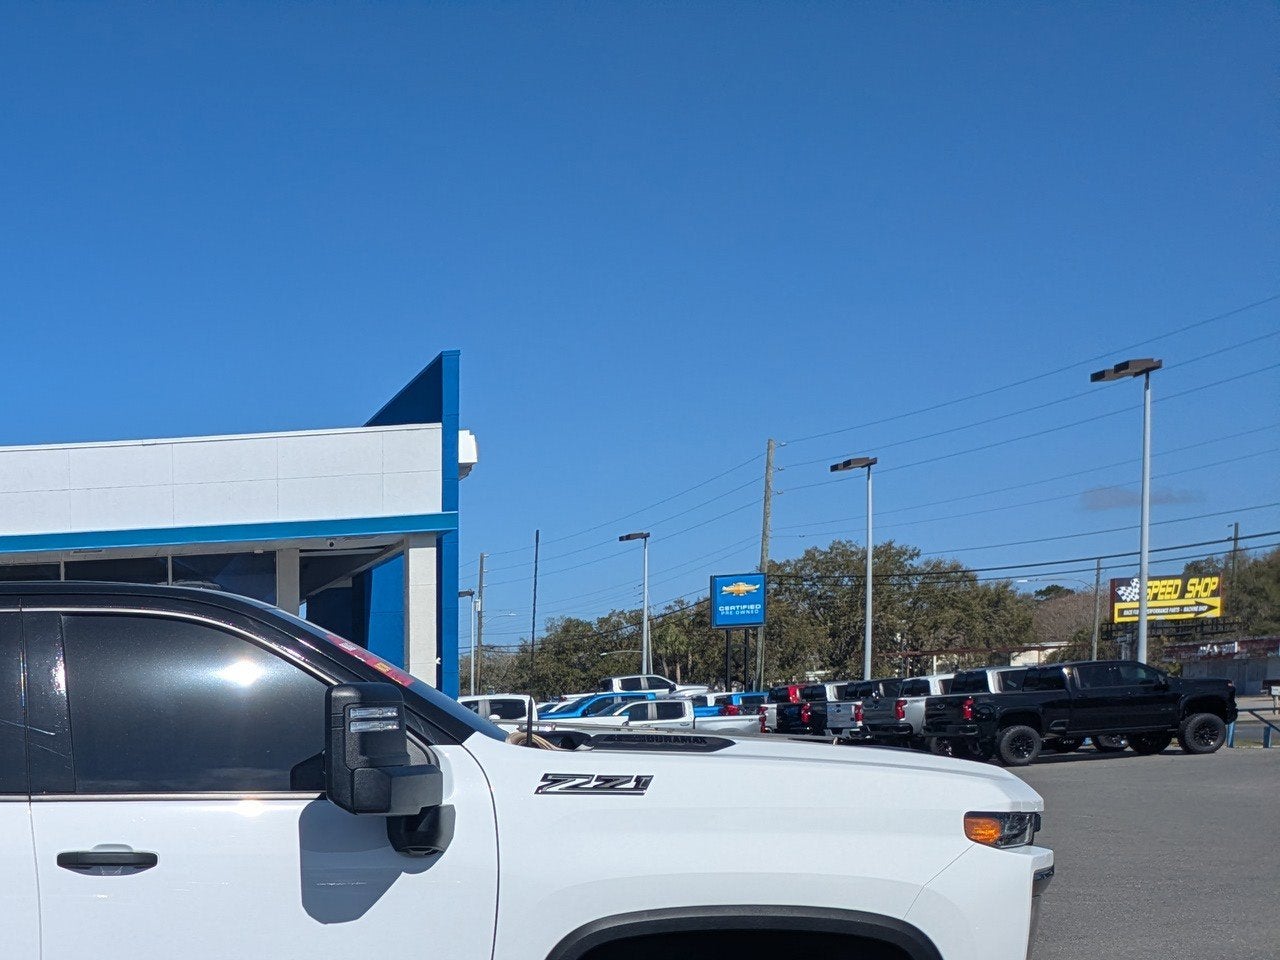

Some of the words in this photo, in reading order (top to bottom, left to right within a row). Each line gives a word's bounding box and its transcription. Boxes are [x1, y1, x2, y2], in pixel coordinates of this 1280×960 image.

[1146, 579, 1181, 600] SPEED
[1184, 577, 1219, 598] SHOP
[534, 773, 654, 796] Z71
